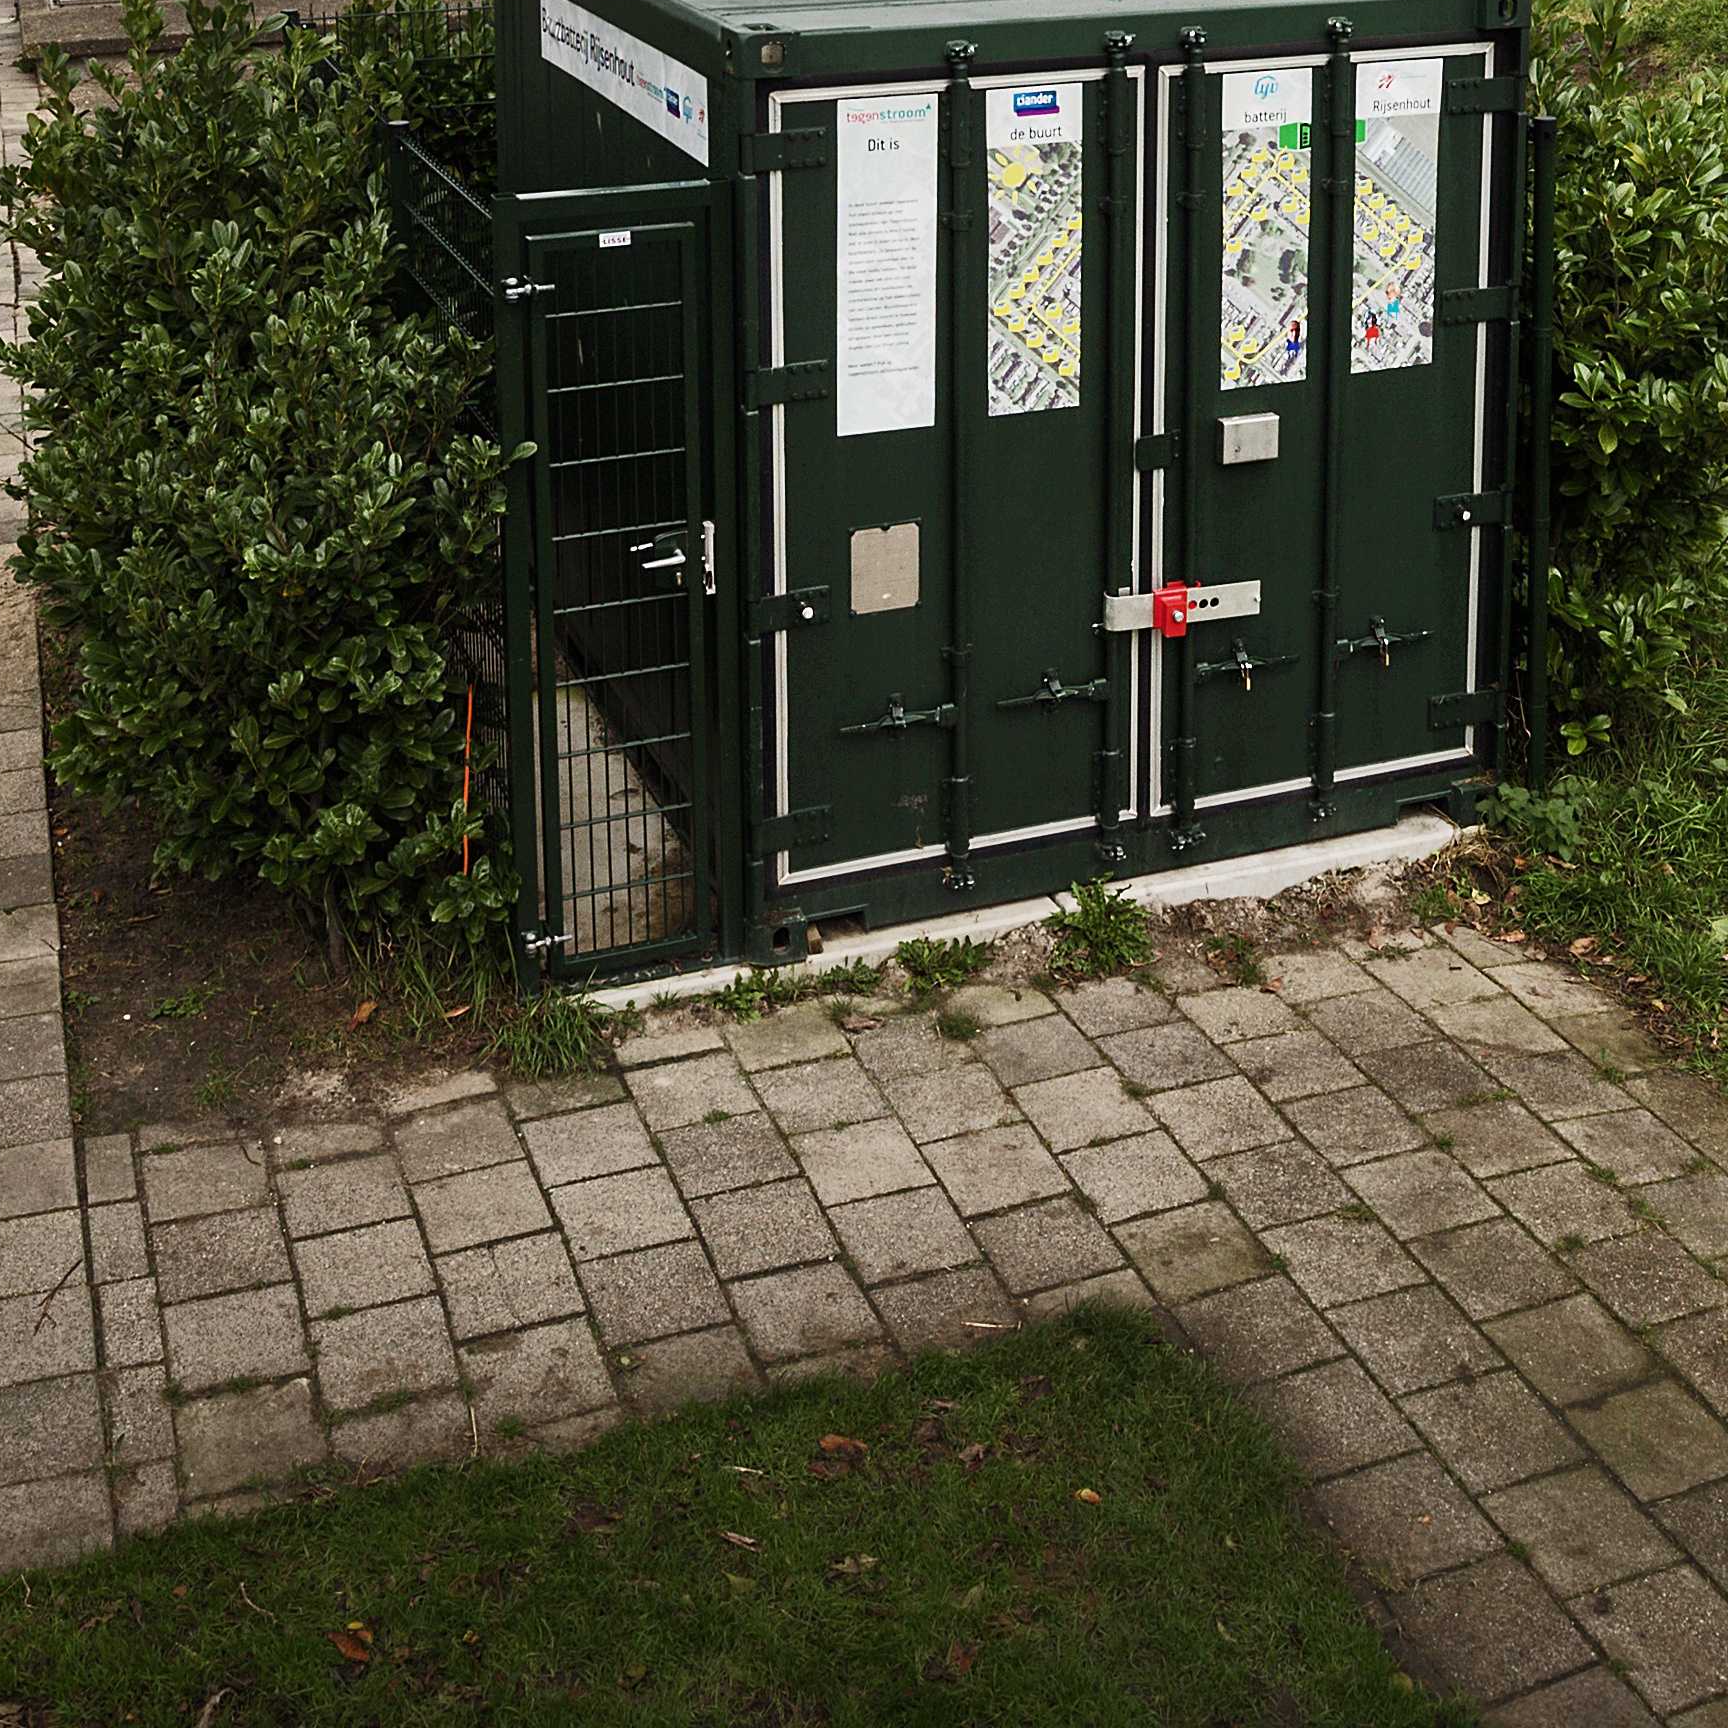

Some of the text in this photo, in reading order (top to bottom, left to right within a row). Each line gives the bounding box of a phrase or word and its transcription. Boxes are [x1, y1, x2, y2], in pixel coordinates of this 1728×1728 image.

[590, 33, 635, 87] Rijsenhout
[1373, 97, 1432, 114] Rijsenhout
[846, 108, 927, 124] tegenstroom
[1244, 108, 1287, 123] batterij
[1010, 126, 1062, 141] de buurt
[867, 137, 900, 152] Dit is
